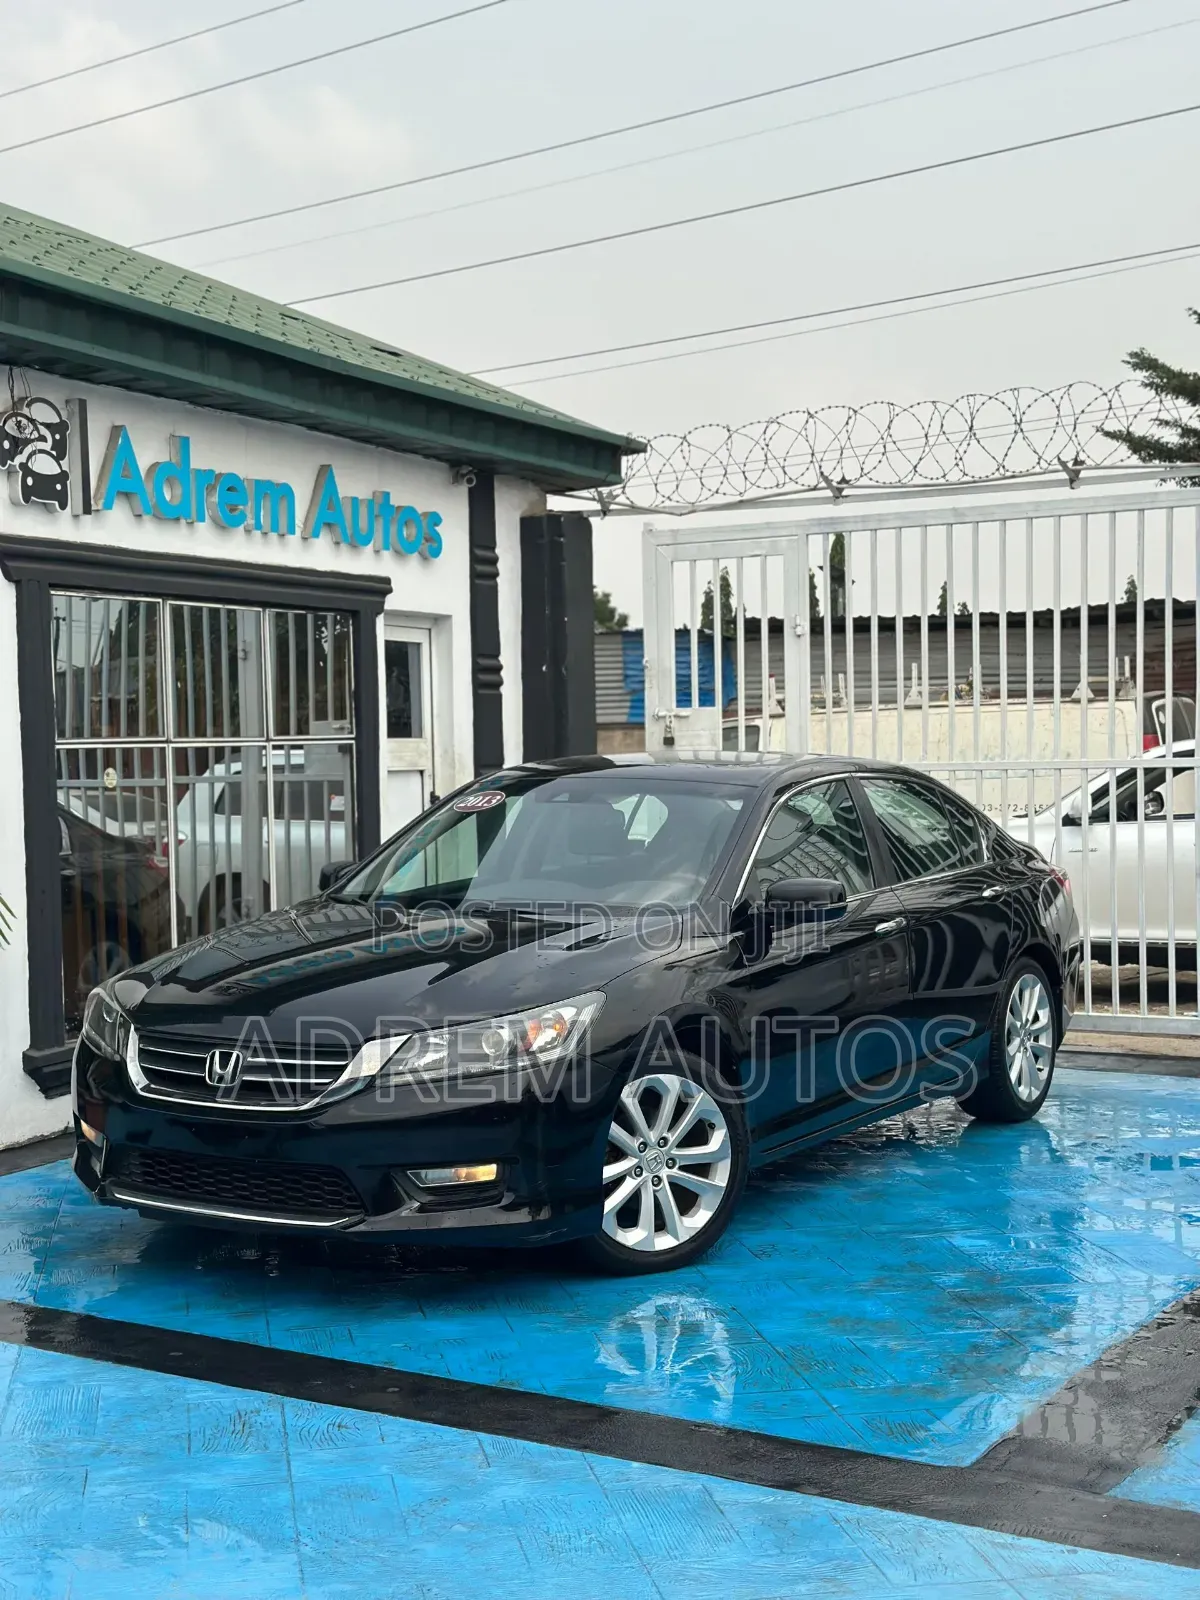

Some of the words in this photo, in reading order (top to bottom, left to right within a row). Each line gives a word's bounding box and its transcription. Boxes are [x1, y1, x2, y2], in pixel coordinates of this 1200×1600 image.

[93, 424, 296, 536] Adrem
[302, 464, 443, 559] Autos
[456, 795, 502, 807] 2013
